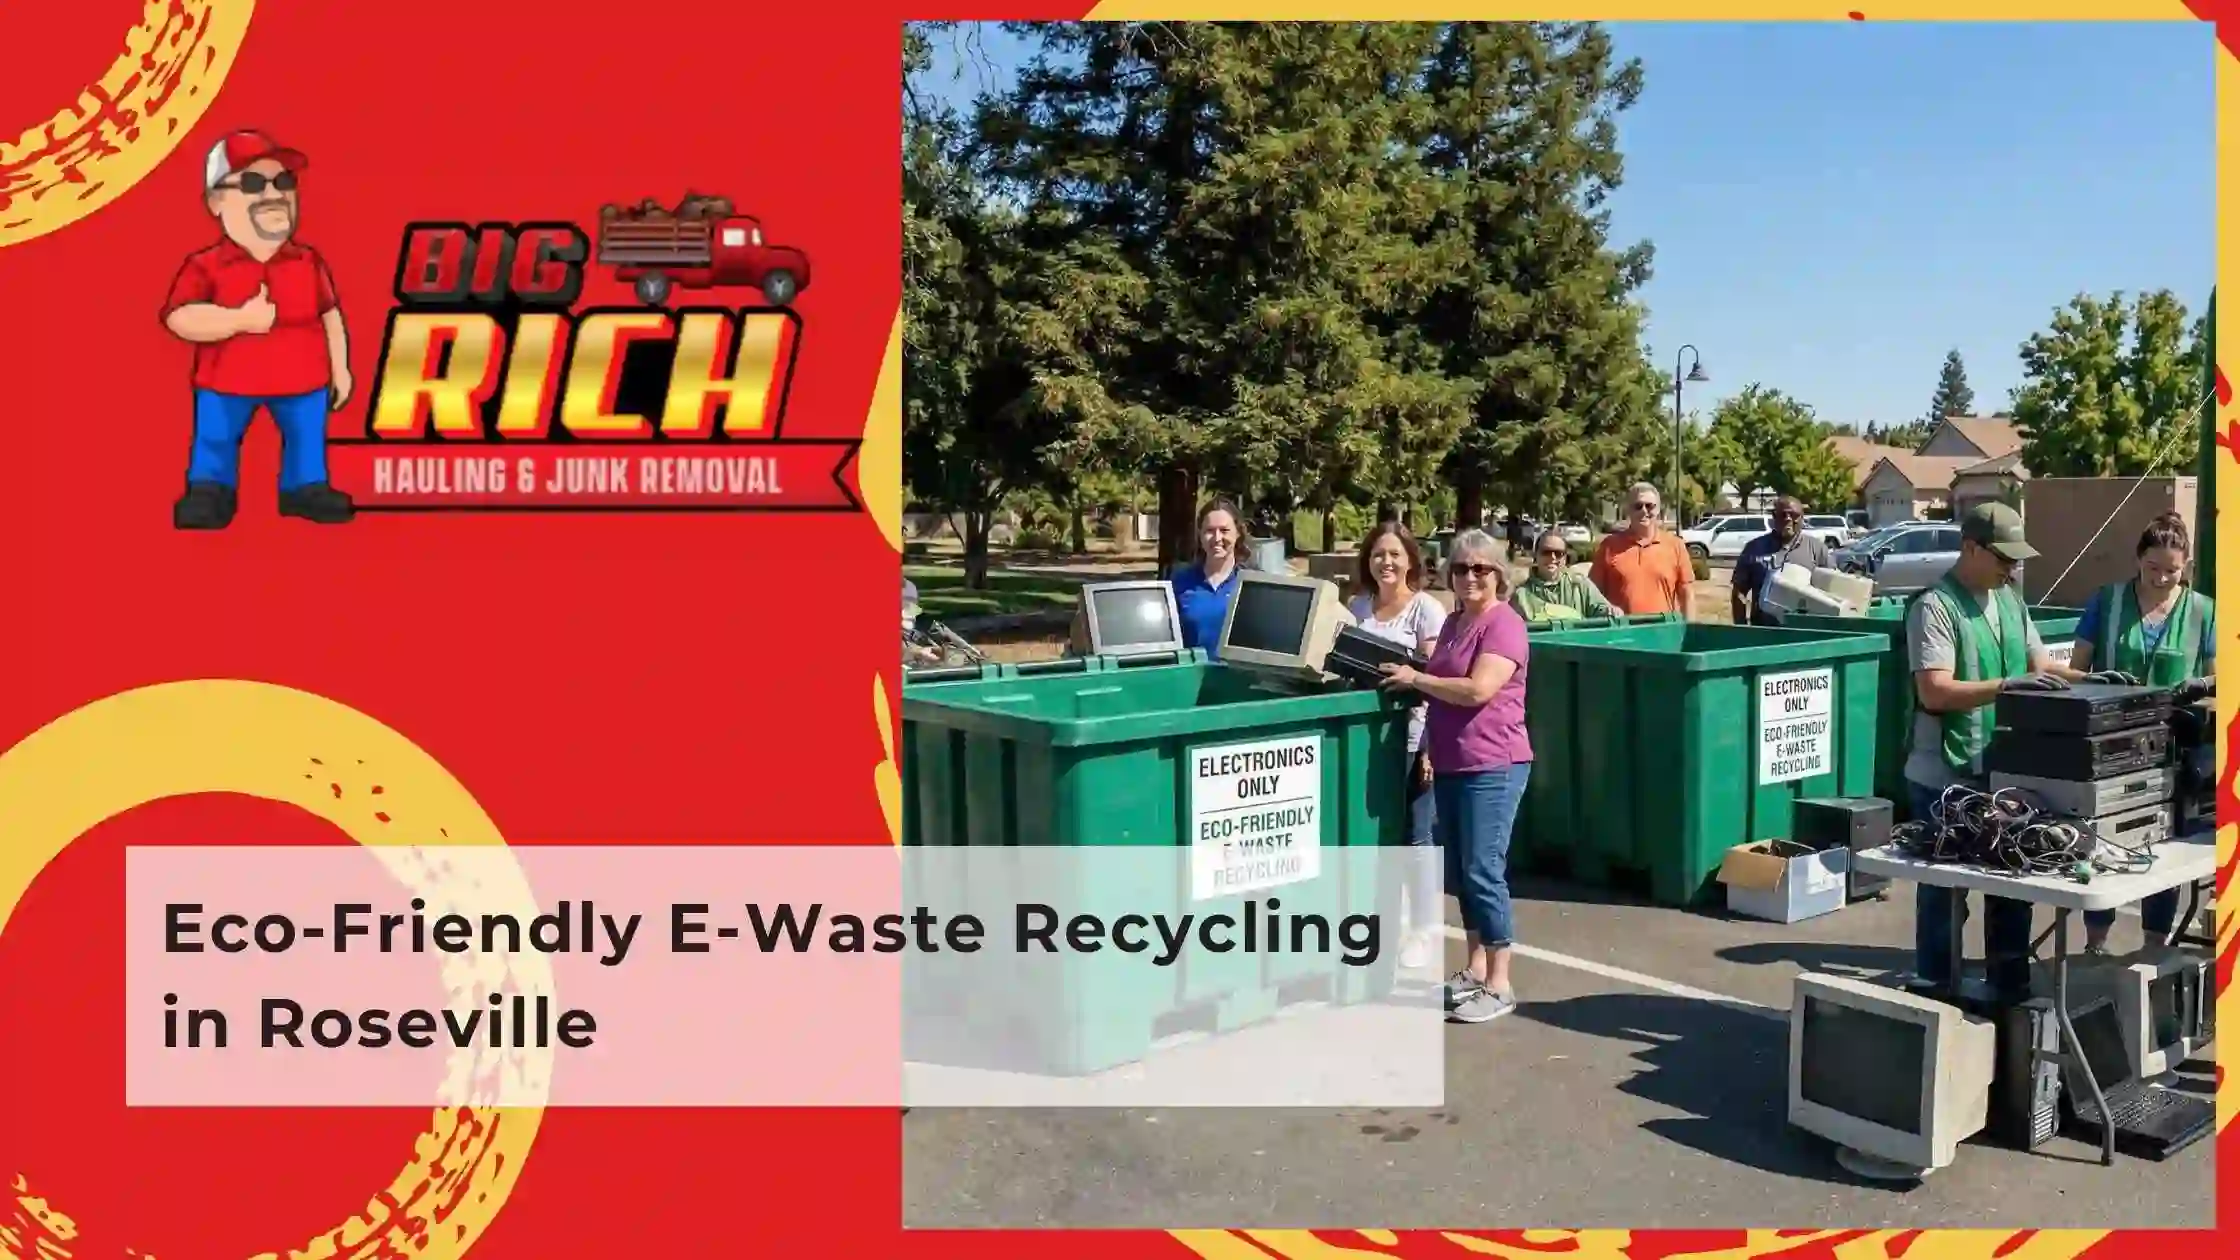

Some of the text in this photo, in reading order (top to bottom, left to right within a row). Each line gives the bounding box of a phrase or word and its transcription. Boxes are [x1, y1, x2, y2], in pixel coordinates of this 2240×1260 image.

[1764, 676, 1829, 696] ELECTRONICS
[1784, 697, 1809, 712] ONLY
[1764, 720, 1829, 742] ECO-FRIENDLY
[1776, 739, 1817, 758] E-WASTE
[1199, 745, 1315, 777] ELECTRONICS
[1771, 755, 1821, 776] RECYCLING
[1237, 775, 1281, 798] ONLY
[1200, 806, 1314, 840] ECO-FRIENDLY
[1223, 832, 1293, 861] EWASTE
